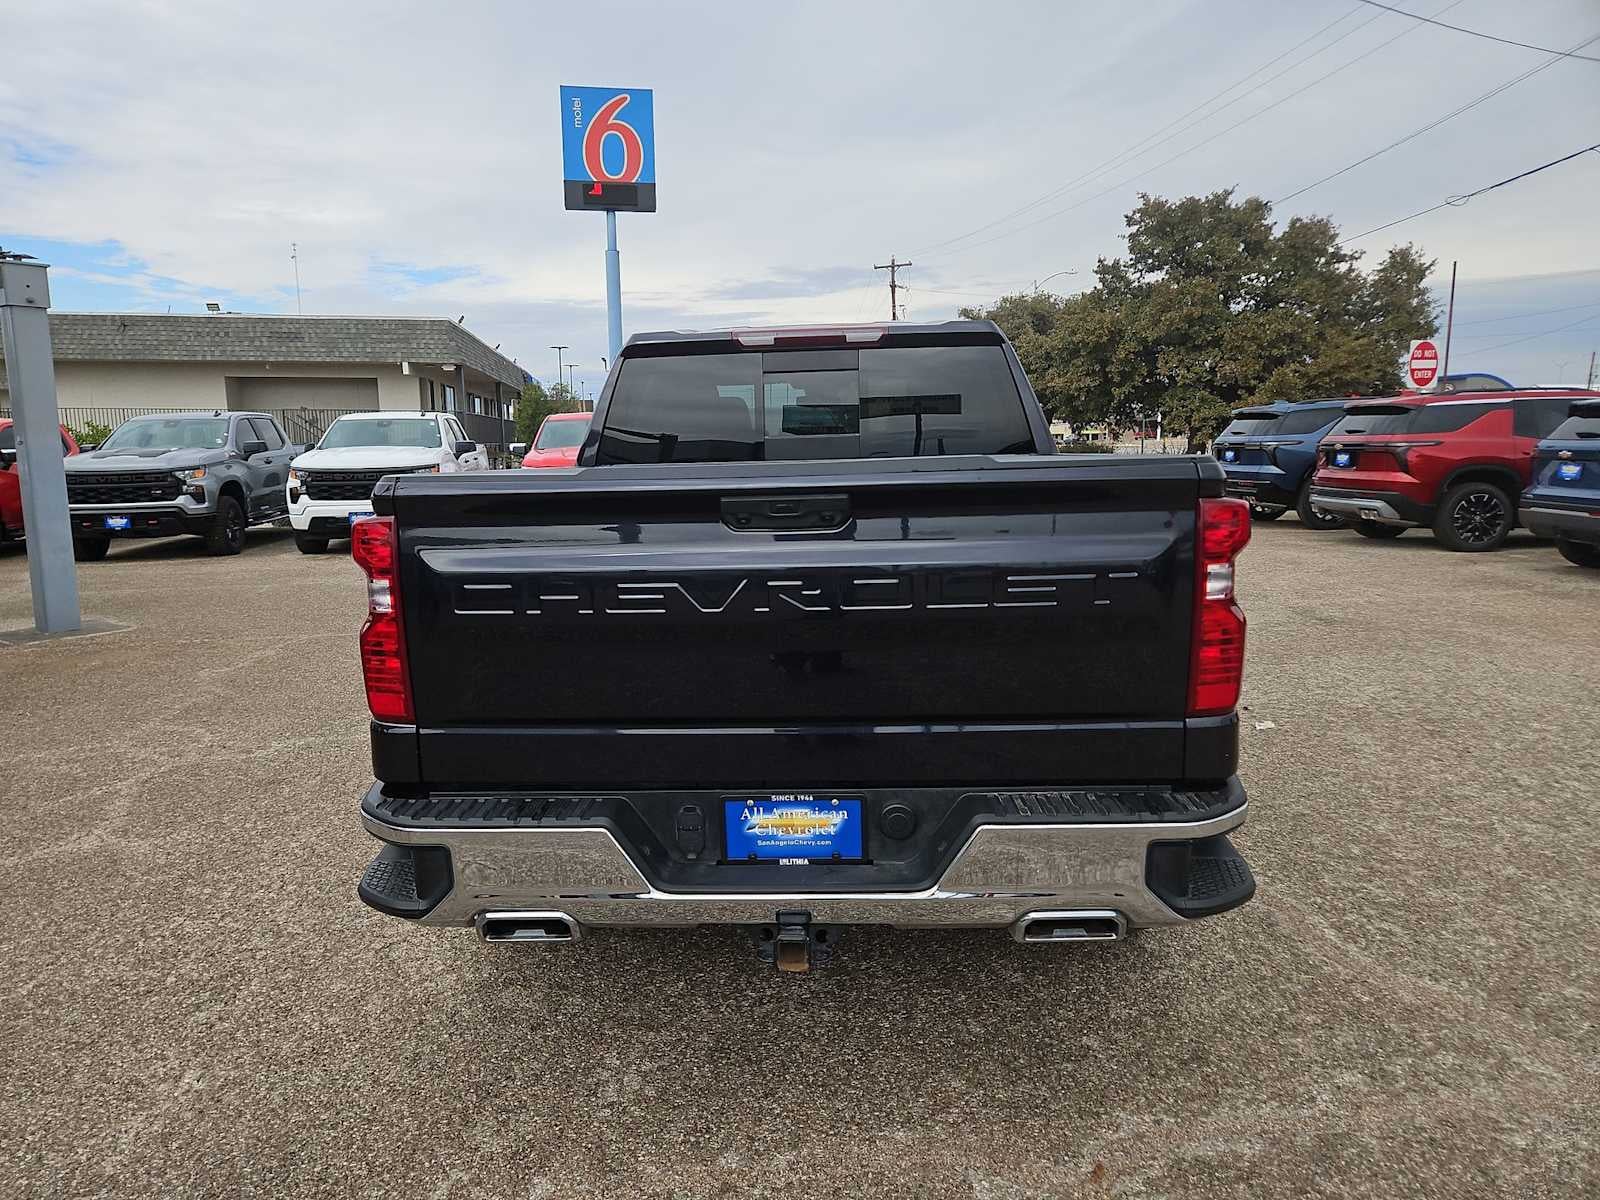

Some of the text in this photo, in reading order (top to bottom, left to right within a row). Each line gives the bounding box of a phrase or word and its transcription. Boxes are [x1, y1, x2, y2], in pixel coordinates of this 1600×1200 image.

[571, 94, 644, 183] motel 6
[1413, 350, 1435, 358] DO NOT
[1414, 370, 1432, 379] ENTER
[452, 571, 1138, 615] CHEVROLET
[740, 807, 848, 820] All American
[755, 823, 837, 836] Chevrolet
